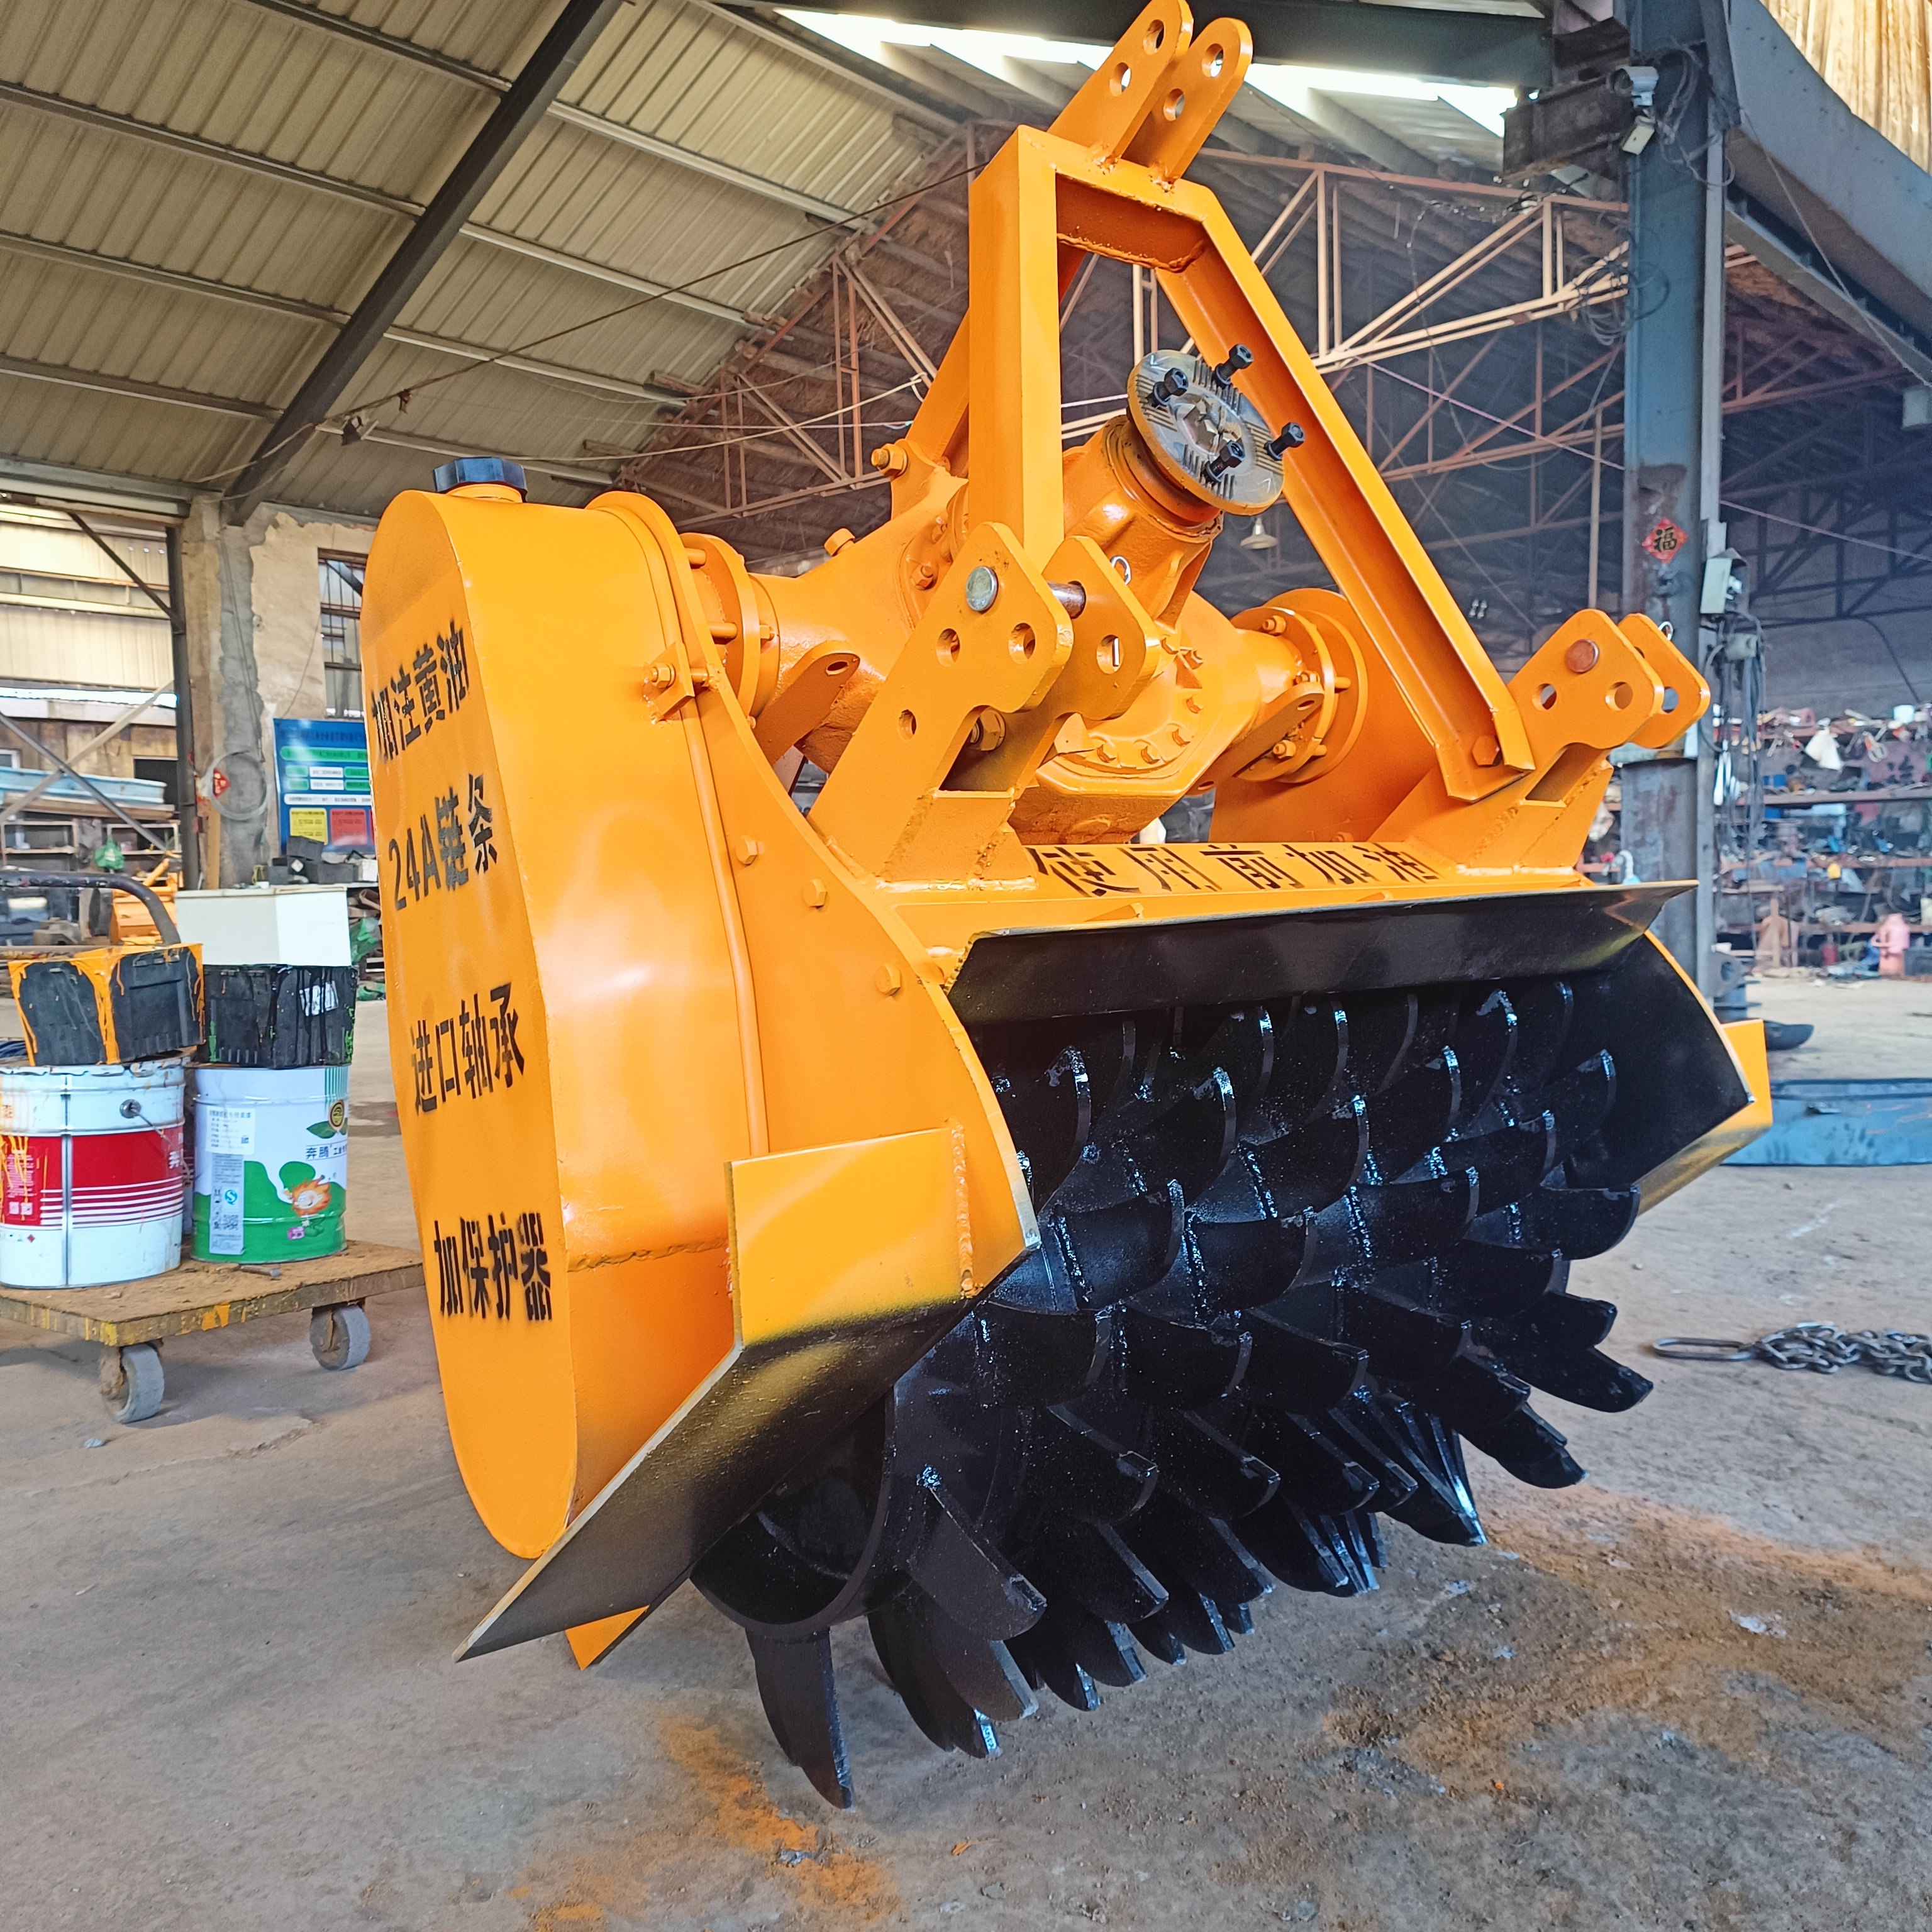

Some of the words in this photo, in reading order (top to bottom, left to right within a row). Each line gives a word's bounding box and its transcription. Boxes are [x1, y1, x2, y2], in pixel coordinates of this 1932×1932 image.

[1654, 526, 1677, 552] 福
[371, 619, 470, 765] 加注黄油
[388, 773, 497, 911] 24A链条
[1026, 844, 1443, 897] 使用前加油
[411, 982, 525, 1115] 进口轴承
[434, 1212, 553, 1321] 加保护器
